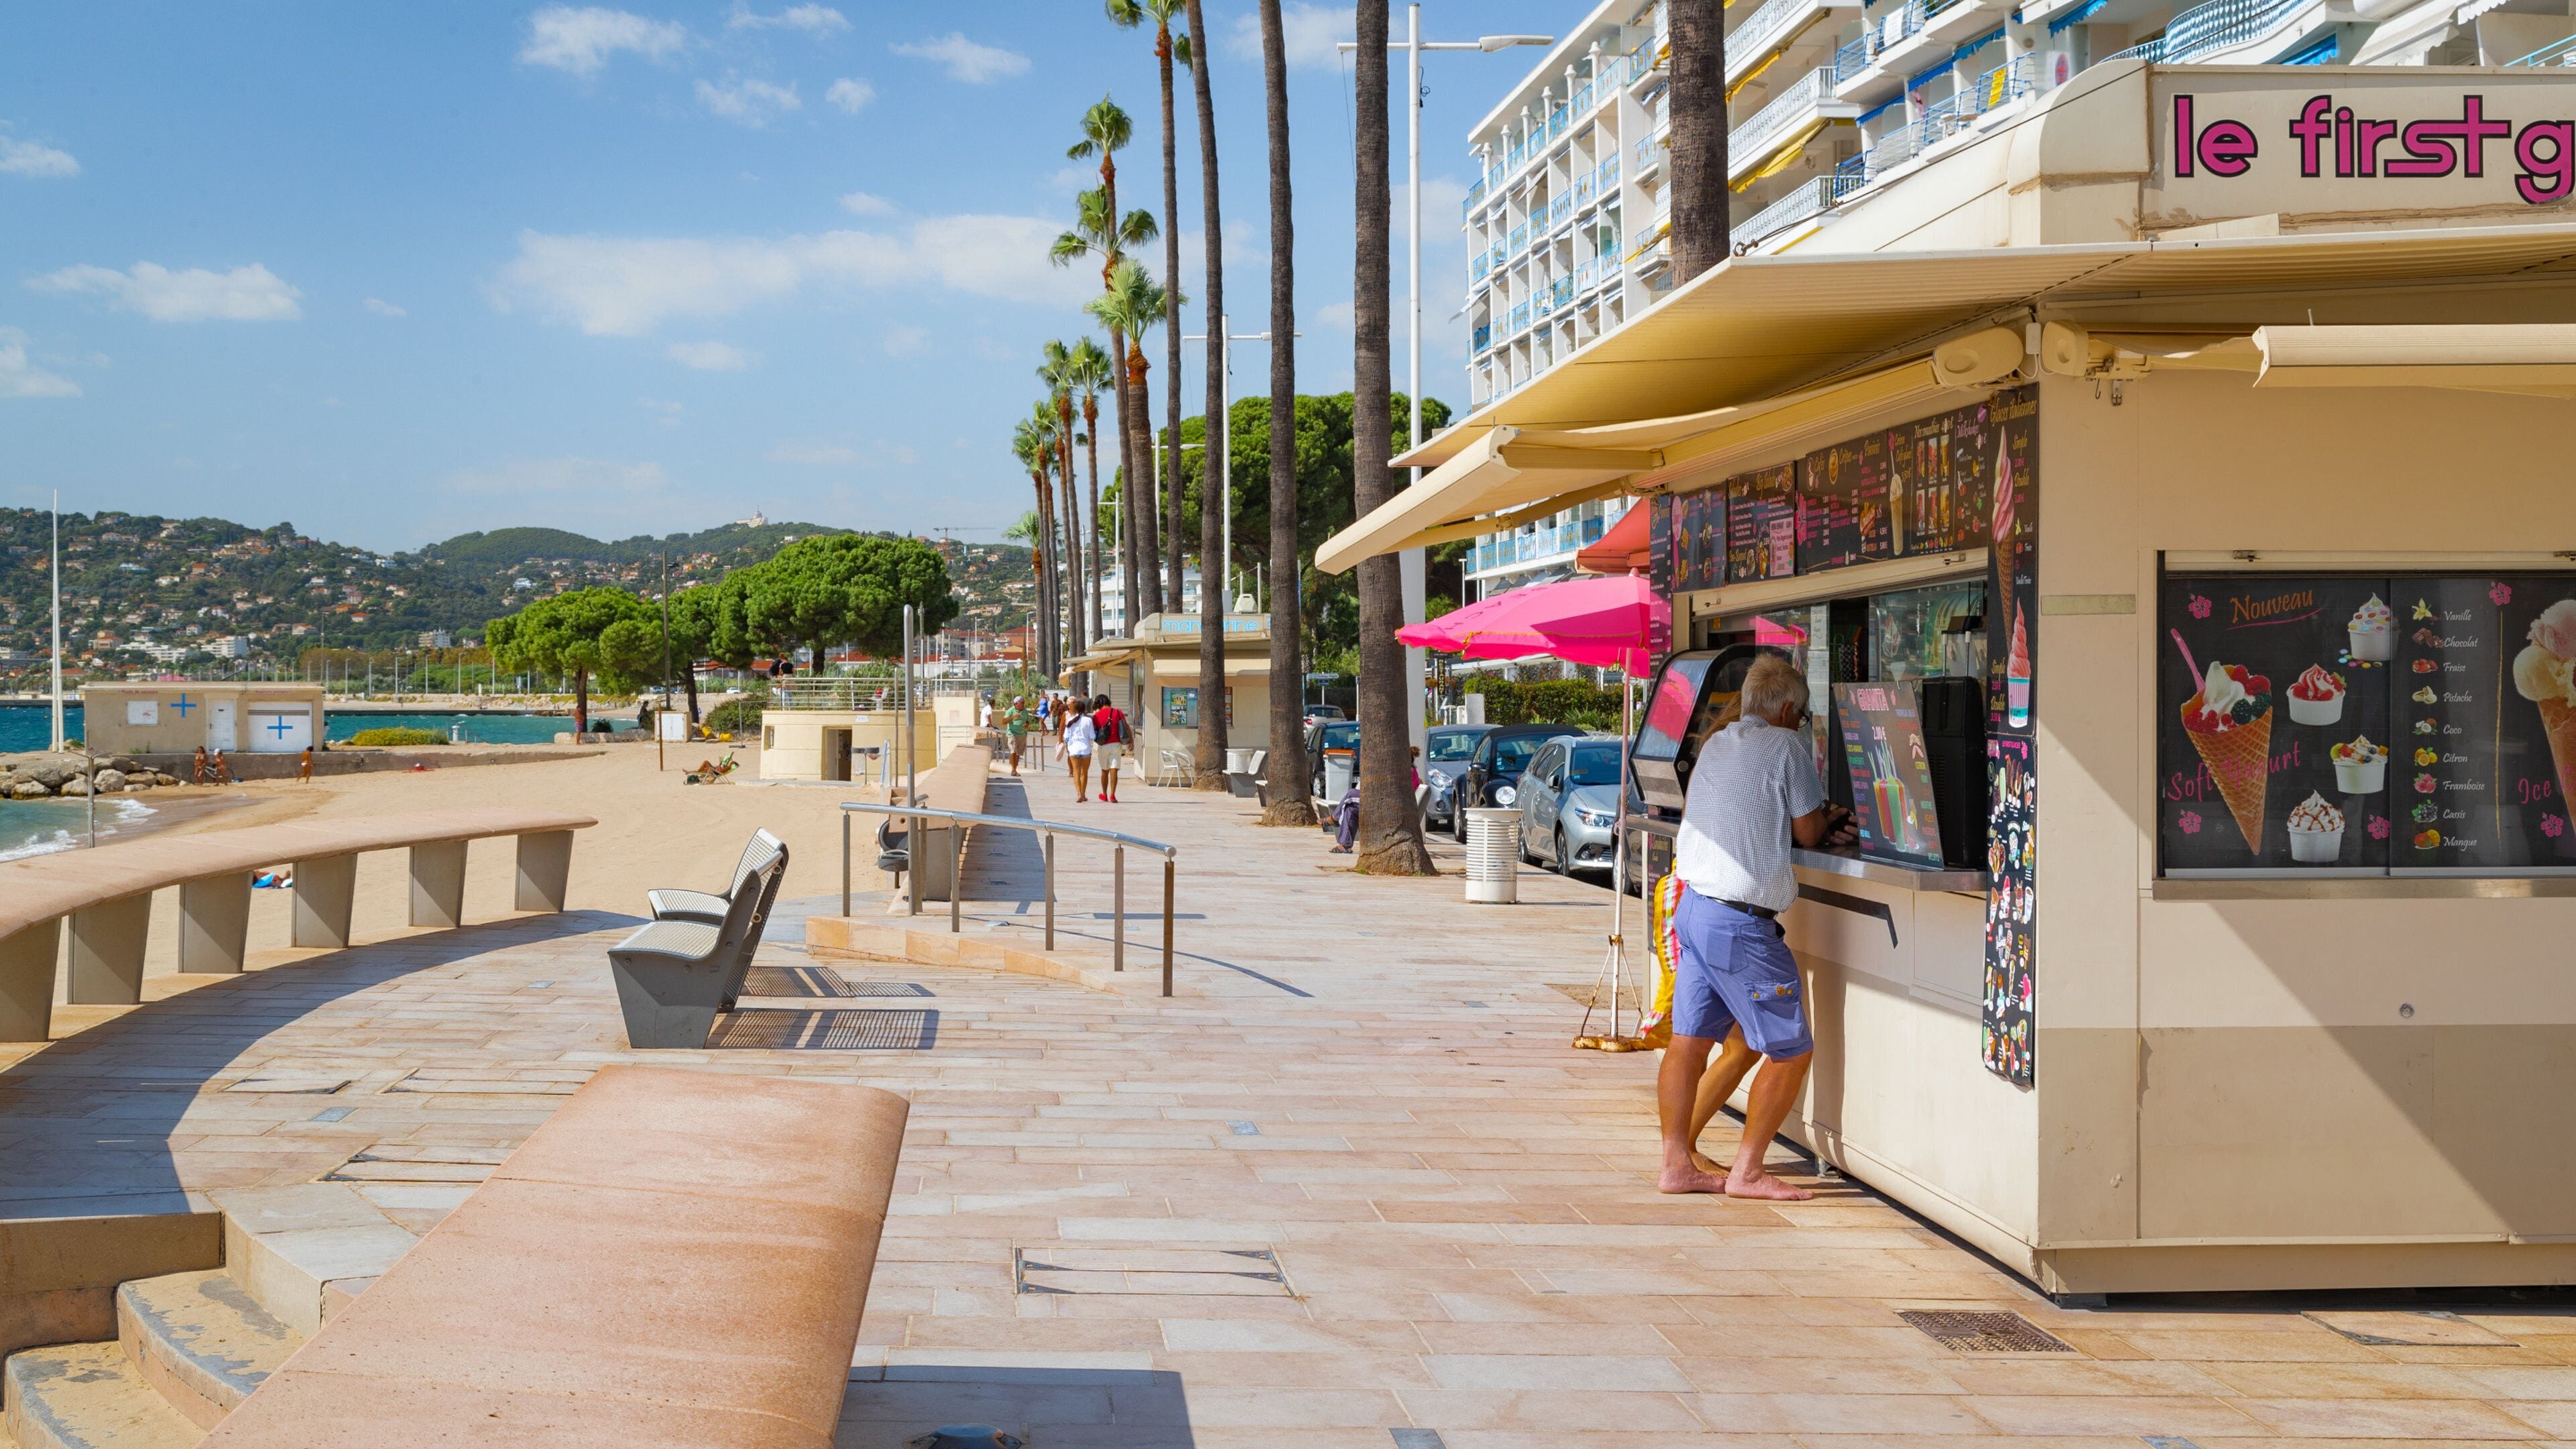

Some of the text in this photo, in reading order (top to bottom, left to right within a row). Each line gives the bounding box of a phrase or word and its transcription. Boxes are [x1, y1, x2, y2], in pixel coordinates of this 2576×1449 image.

[2174, 95, 2258, 178] le
[2230, 590, 2312, 623] Nouveau
[2444, 609, 2471, 621] Vanille
[1163, 620, 1258, 633] manrine
[2444, 636, 2479, 648] Chocolat
[2443, 662, 2466, 672] Fraise
[1857, 688, 1889, 711] GRANITA
[2443, 691, 2472, 702] Pistache
[2443, 724, 2462, 735] Coco
[2443, 753, 2467, 763] Citron
[2167, 741, 2301, 802] Soft Yaourt
[2443, 779, 2485, 790] Framboise
[2518, 777, 2552, 804] Ice
[2443, 809, 2466, 819] Cassis
[2443, 837, 2477, 851] Mangue
